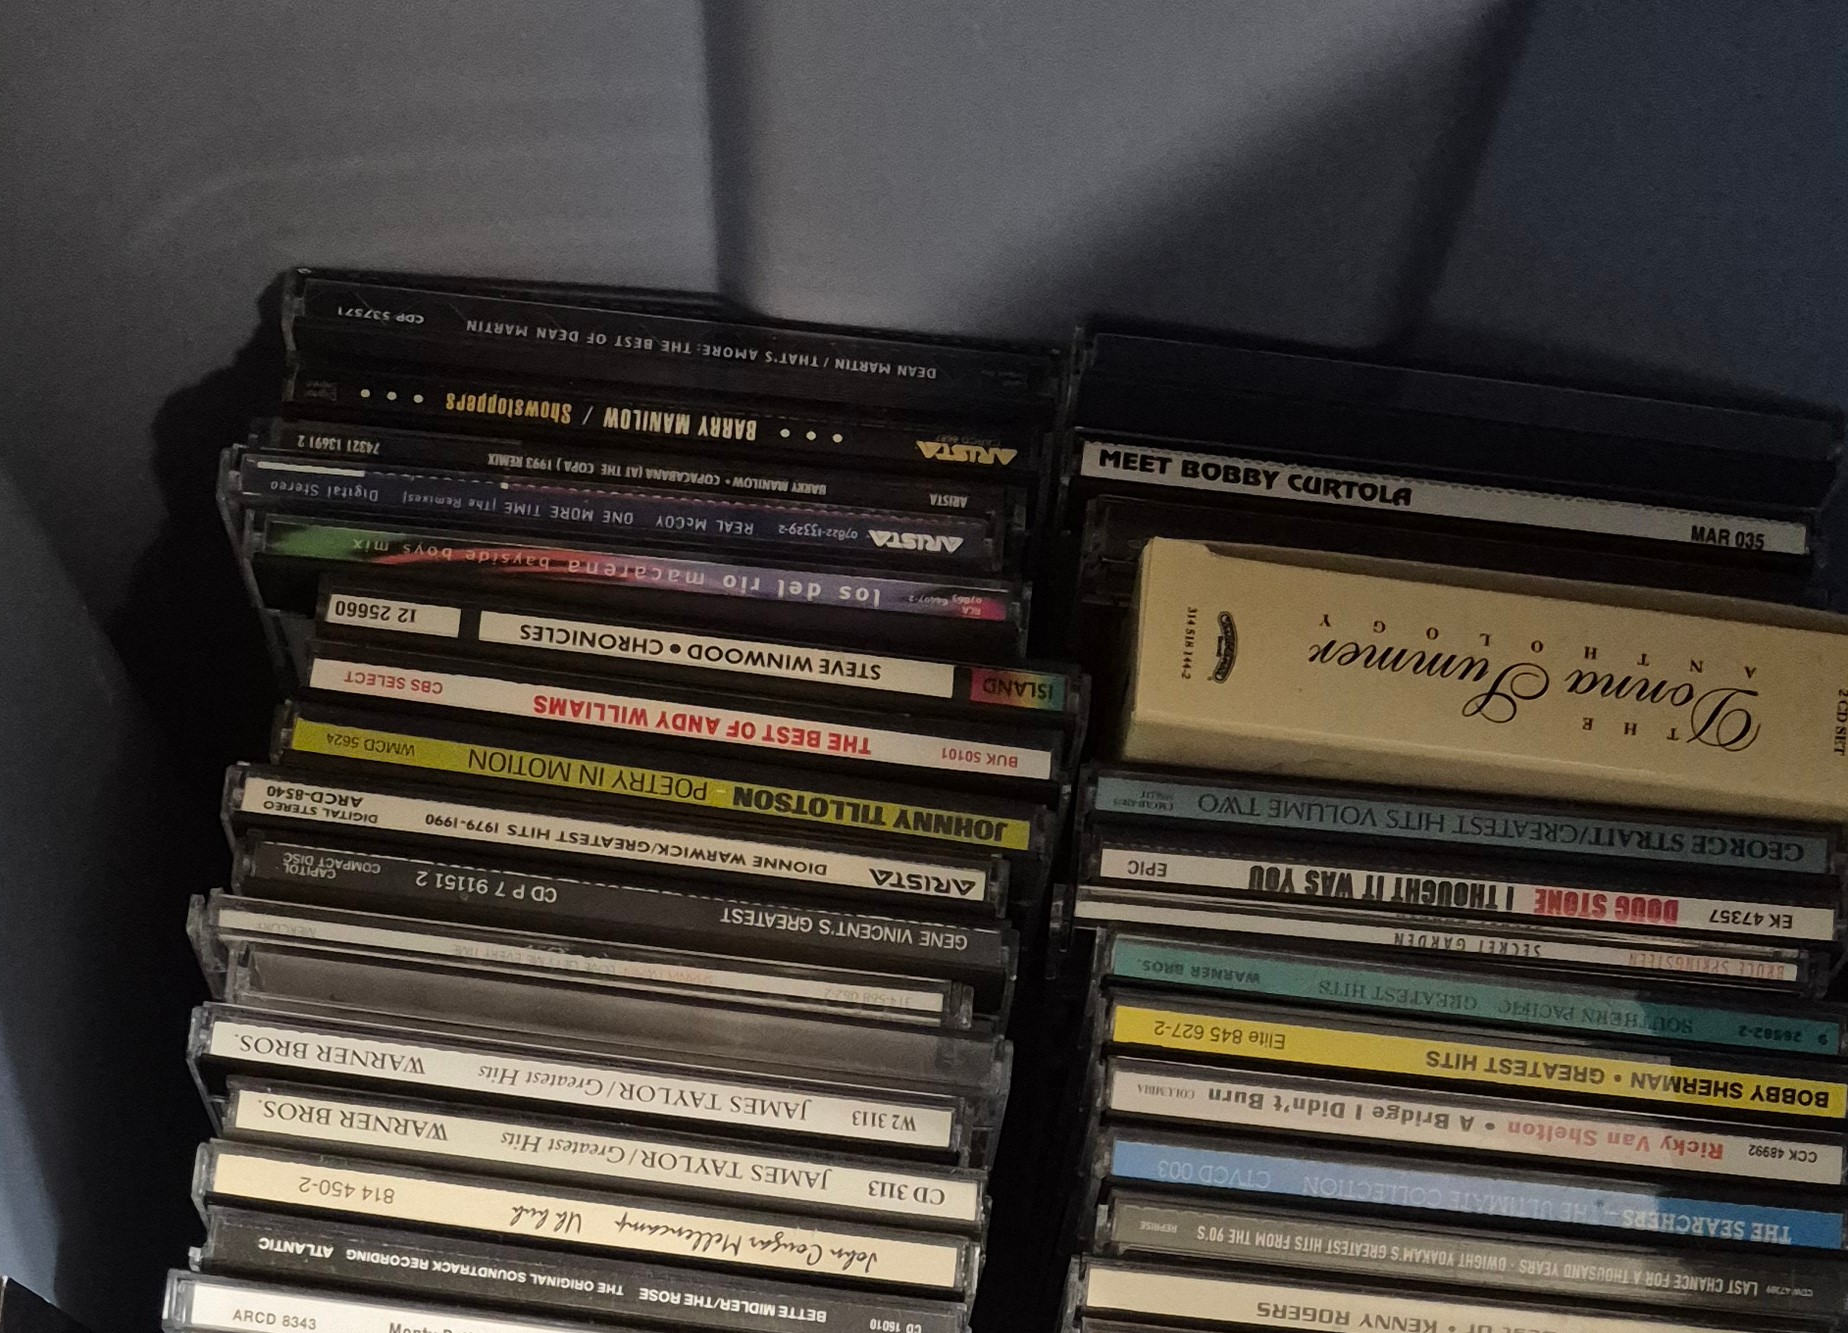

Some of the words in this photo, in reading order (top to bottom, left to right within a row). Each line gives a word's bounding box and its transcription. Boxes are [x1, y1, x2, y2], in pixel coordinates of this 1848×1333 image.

[395, 313, 424, 324] CDP
[445, 392, 572, 423] Showstoppers
[602, 406, 689, 434] MANILOW
[697, 415, 756, 440] BARRY
[1099, 449, 1172, 474] MEET
[1180, 459, 1279, 490] BOBBY
[1287, 474, 1412, 506] CURTOLA
[1690, 525, 1730, 546] MAR
[1734, 531, 1765, 550] 035
[520, 624, 663, 655] CHRONICLES
[687, 643, 812, 672] WINWOOD
[819, 658, 881, 680] STEVE
[1307, 641, 1550, 723] Summer
[533, 695, 648, 726] WILLIAMS
[655, 710, 720, 734] ANDY
[1567, 669, 1760, 752] Donna
[726, 720, 756, 739] OF
[761, 724, 821, 747] BEST
[827, 732, 871, 754] THE
[730, 786, 887, 828] TILLOTSON
[892, 807, 1008, 844] JOHNNY
[1127, 860, 1167, 877] EPIC
[719, 907, 812, 932] GREATEST
[1709, 909, 1763, 925] 47357
[1768, 913, 1792, 929] EK
[818, 919, 912, 943] VINCENT'S
[918, 930, 967, 950] GENE
[1426, 1050, 1477, 1070] HITS
[1483, 1057, 1604, 1084] GREATEST
[1631, 1072, 1743, 1099] SHERMAN
[1749, 1084, 1828, 1108] BOBBY
[258, 1100, 332, 1125] BROS.
[339, 1110, 447, 1140] WARNER
[868, 1180, 908, 1200] 3113
[912, 1186, 944, 1205] CD
[258, 1237, 333, 1257] ATLANTIC
[1256, 1302, 1350, 1325] ROGERS
[1358, 1313, 1437, 1333] KENNY
